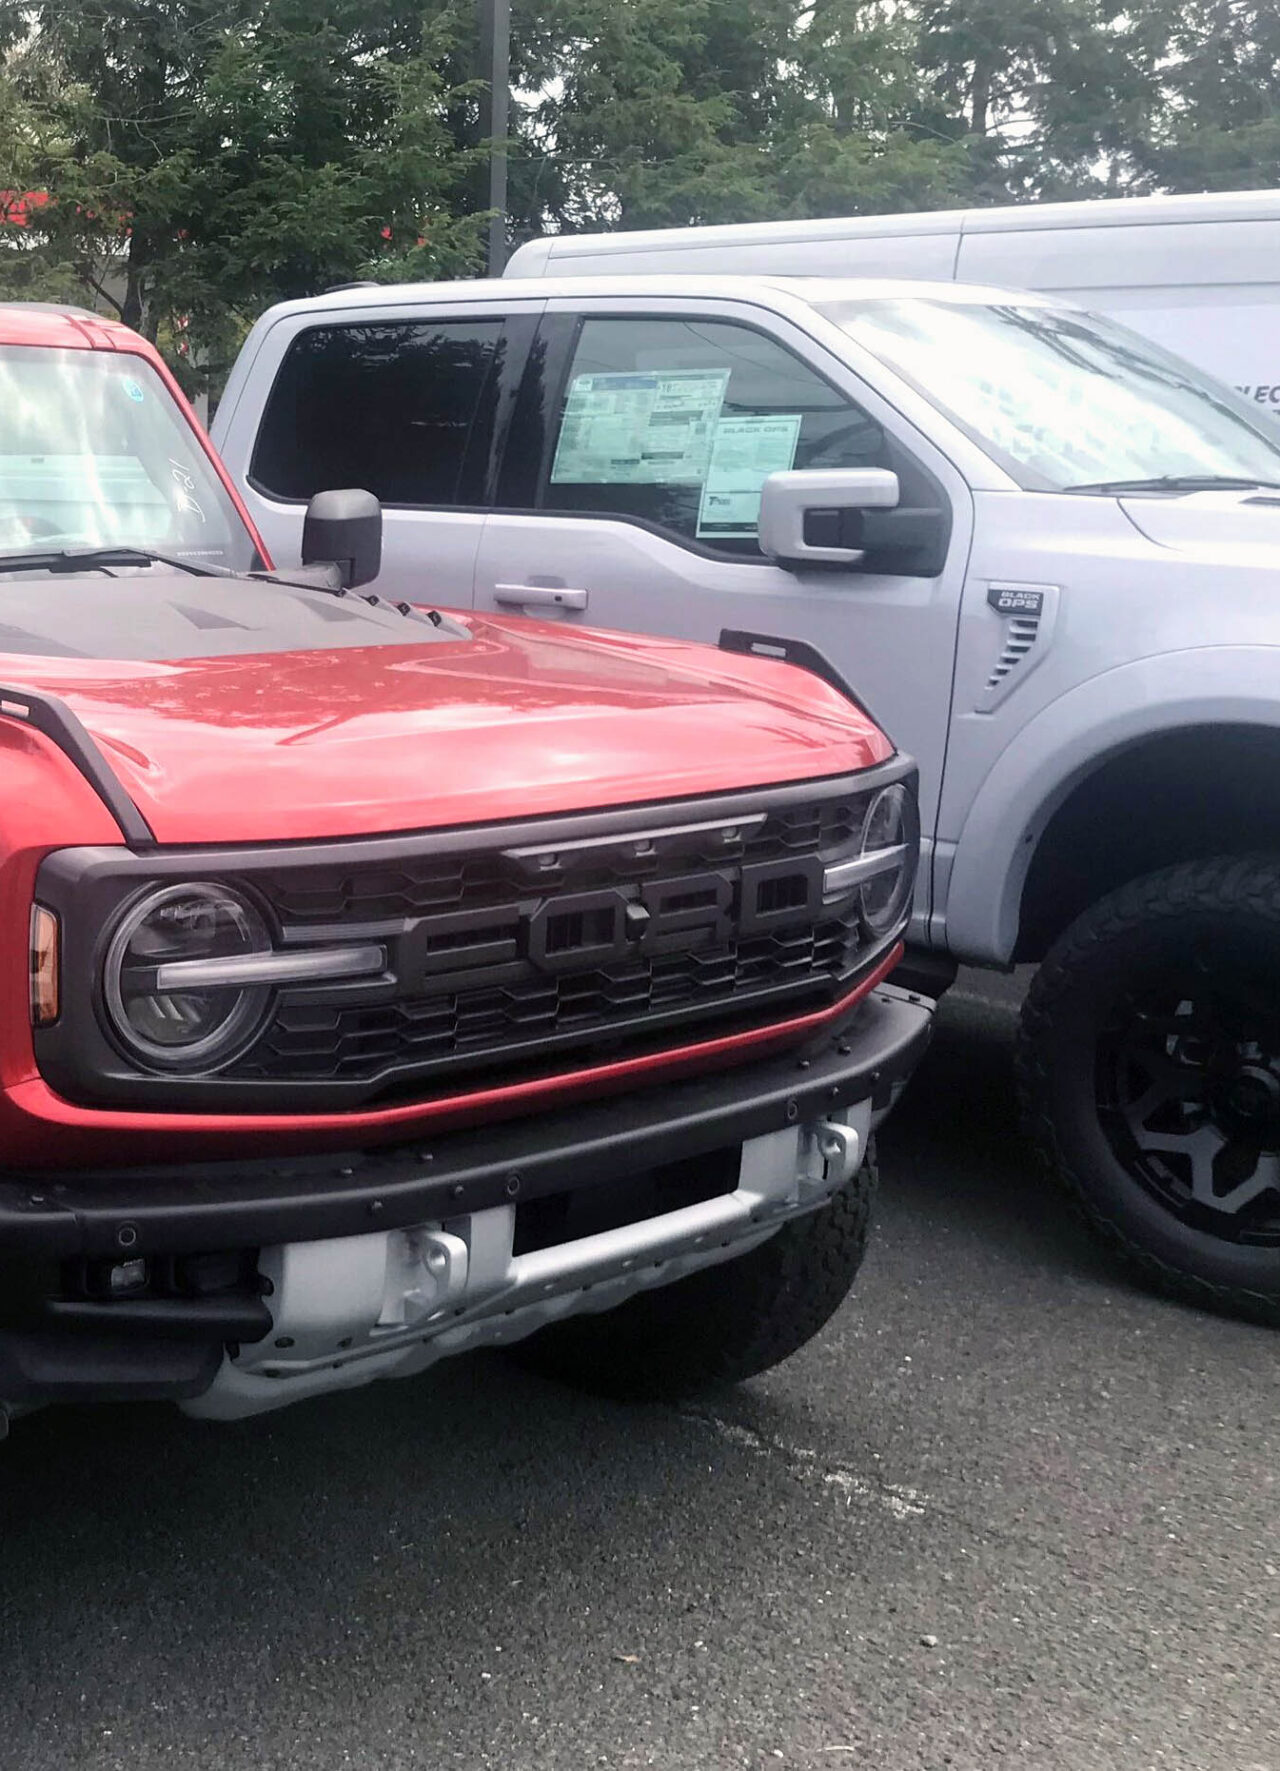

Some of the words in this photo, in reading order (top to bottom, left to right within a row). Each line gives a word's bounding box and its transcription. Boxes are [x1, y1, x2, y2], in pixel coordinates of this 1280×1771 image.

[723, 426, 760, 435] BLACK
[763, 425, 789, 433] OPS
[1001, 591, 1040, 600] BLACK
[998, 598, 1038, 609] OPS
[398, 856, 823, 994] FORD
